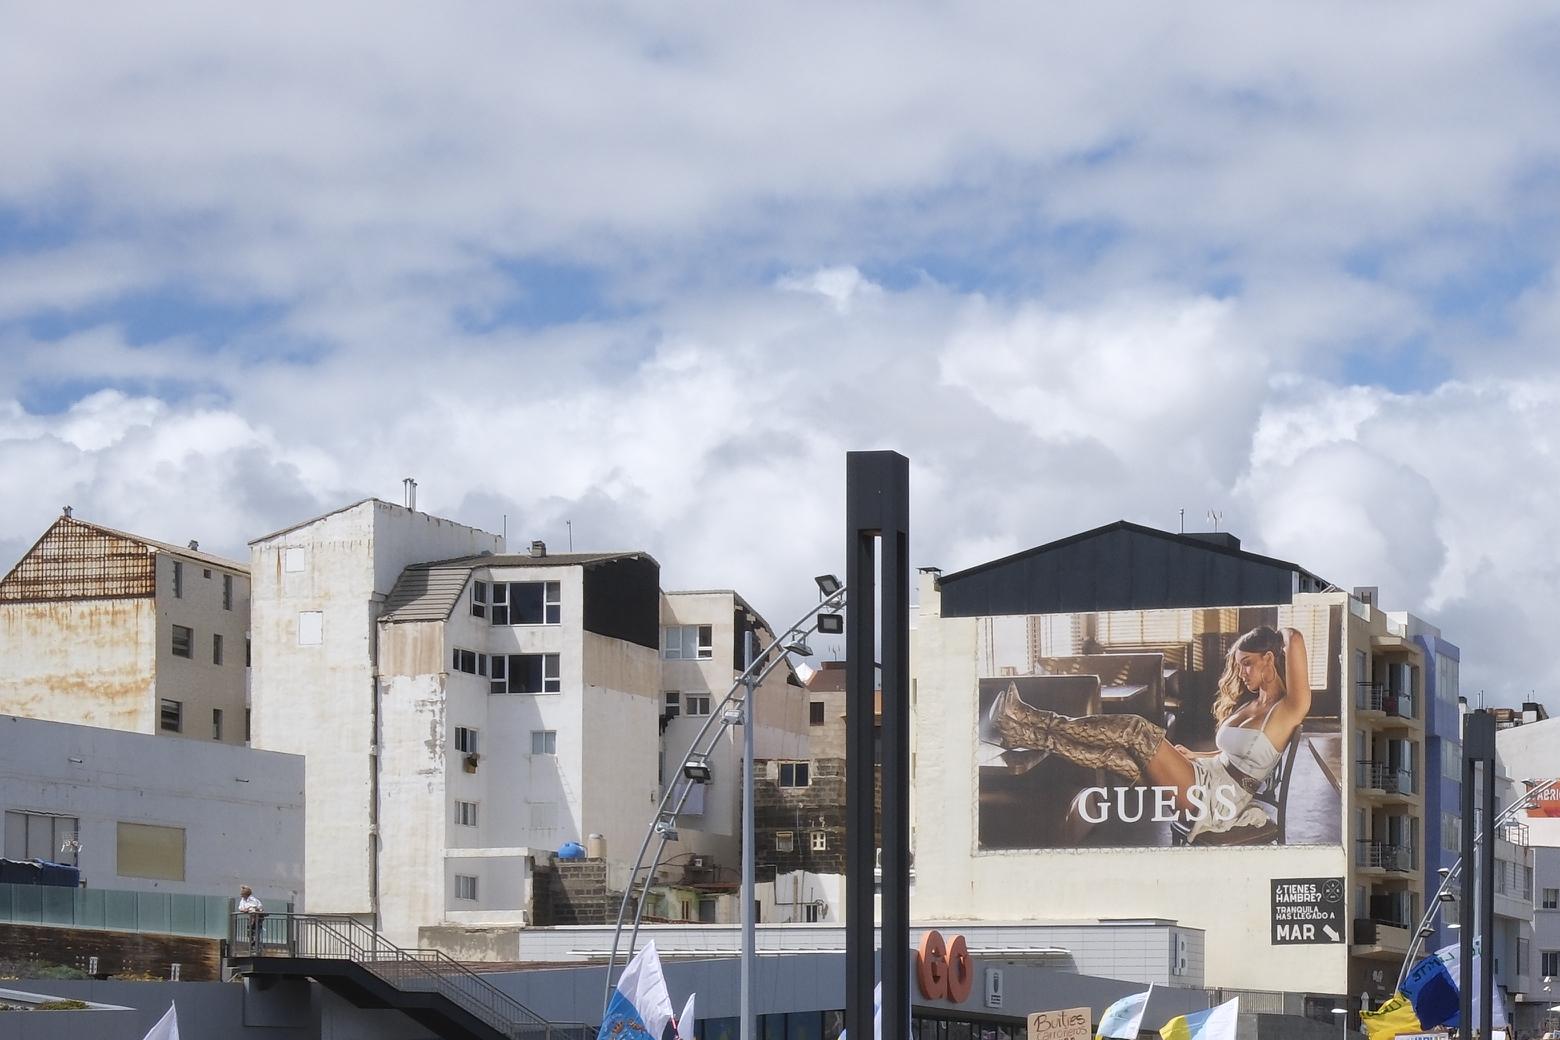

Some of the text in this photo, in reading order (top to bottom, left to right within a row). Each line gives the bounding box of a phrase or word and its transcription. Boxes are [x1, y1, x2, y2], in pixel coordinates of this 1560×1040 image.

[1077, 784, 1238, 824] GUESS
[1276, 884, 1317, 895] ¿TIENES
[1276, 893, 1322, 903] HAMBRE?
[1276, 906, 1319, 914] TRANQUILA
[1276, 911, 1336, 920] HAS LLEGADO A
[1276, 924, 1315, 941] MAR
[917, 930, 974, 1004] GO
